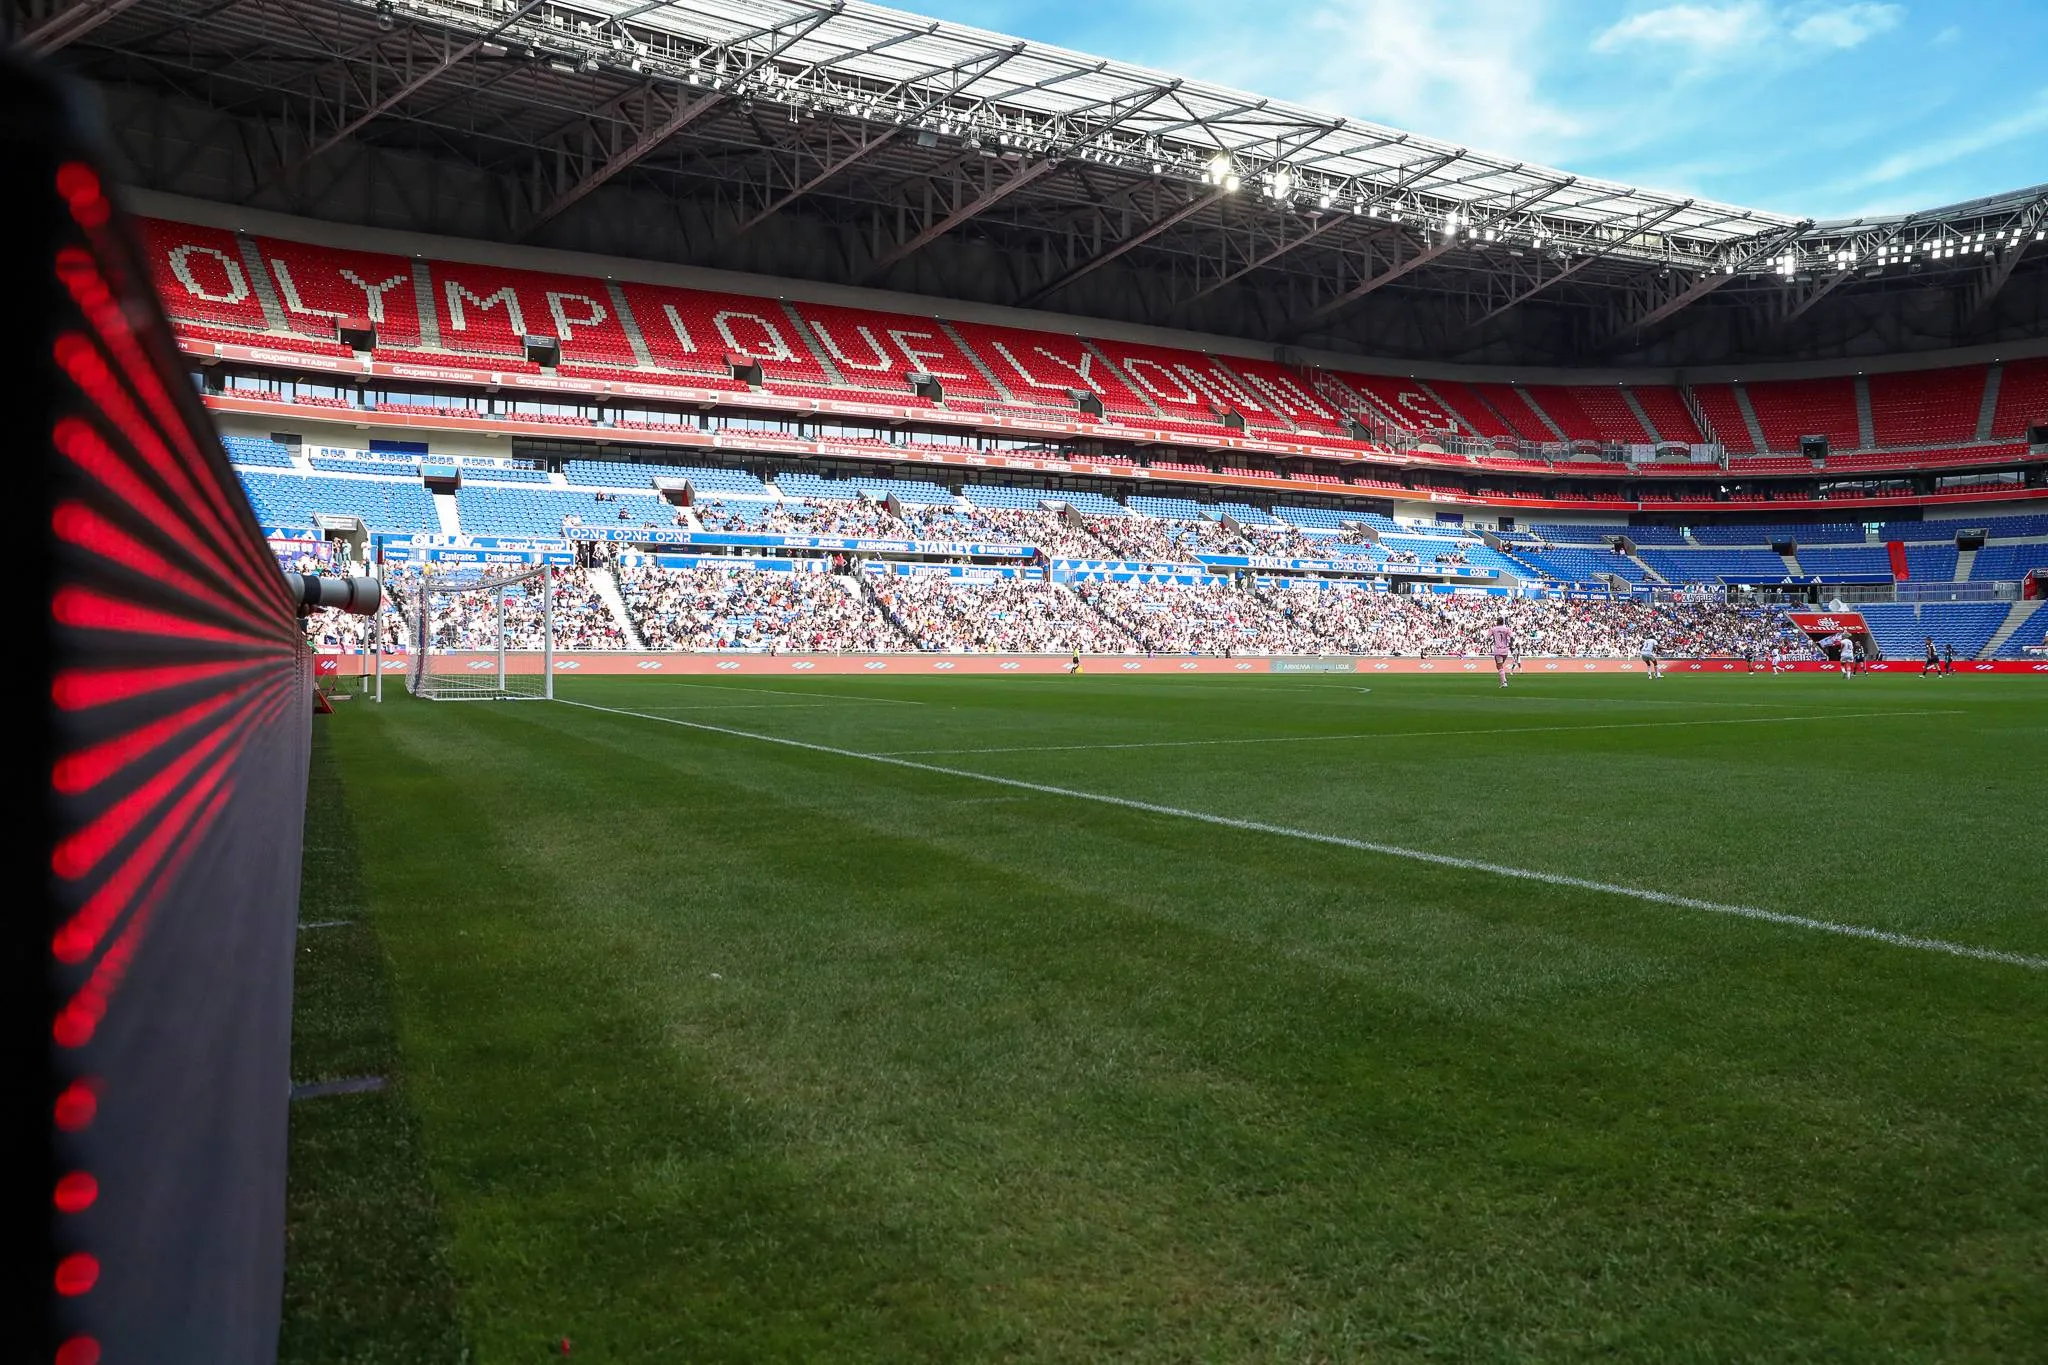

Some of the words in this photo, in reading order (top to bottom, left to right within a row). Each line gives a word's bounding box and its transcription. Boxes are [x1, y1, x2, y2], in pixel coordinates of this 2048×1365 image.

[168, 244, 967, 380] OLYMPIQUE
[250, 350, 299, 364] Groupama
[301, 358, 337, 368] STADIUM
[393, 366, 437, 378] Groupama
[440, 371, 473, 380] STADIUM
[516, 376, 558, 387] Groupama
[560, 380, 591, 390] STADIUM
[570, 528, 607, 540] OPNR
[614, 529, 650, 541] OPNR
[656, 532, 691, 542] OPNR
[916, 542, 973, 554] STANLEY
[440, 552, 477, 561] Emirates
[485, 553, 522, 562] Emirates
[1248, 558, 1292, 568] STANLEY
[909, 566, 950, 576] Emirates
[962, 568, 1003, 578] Emirates
